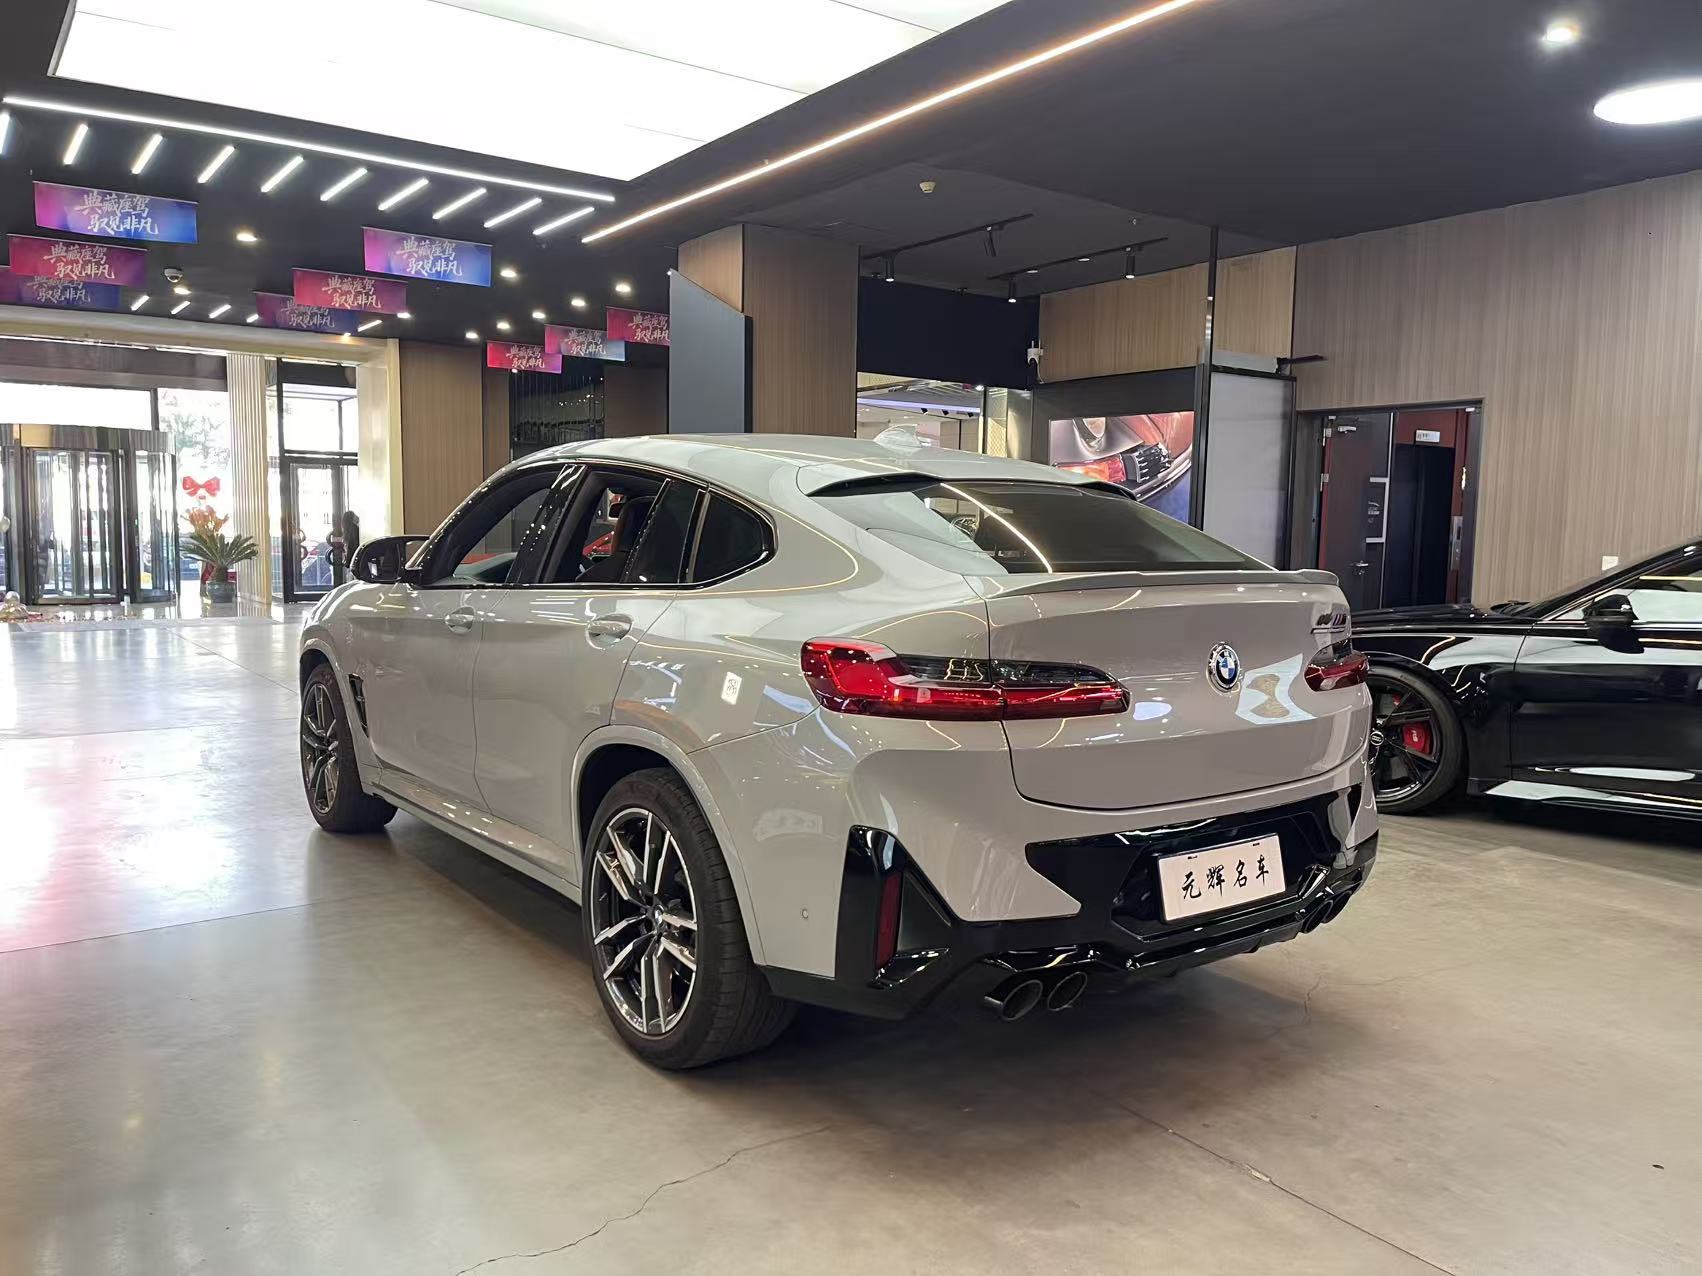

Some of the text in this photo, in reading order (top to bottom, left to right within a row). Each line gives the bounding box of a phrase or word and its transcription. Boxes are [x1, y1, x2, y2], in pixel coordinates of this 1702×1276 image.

[74, 191, 150, 217] 典藏座驾
[88, 214, 159, 236] 驭见非凡
[43, 241, 108, 264] 典藏座驾
[396, 236, 456, 260] 典藏座驾
[55, 262, 115, 280] 驭见非凡
[407, 258, 463, 278] 驭见非凡
[322, 275, 375, 295] 典藏座驾
[1181, 855, 1269, 899] 元辉名车
